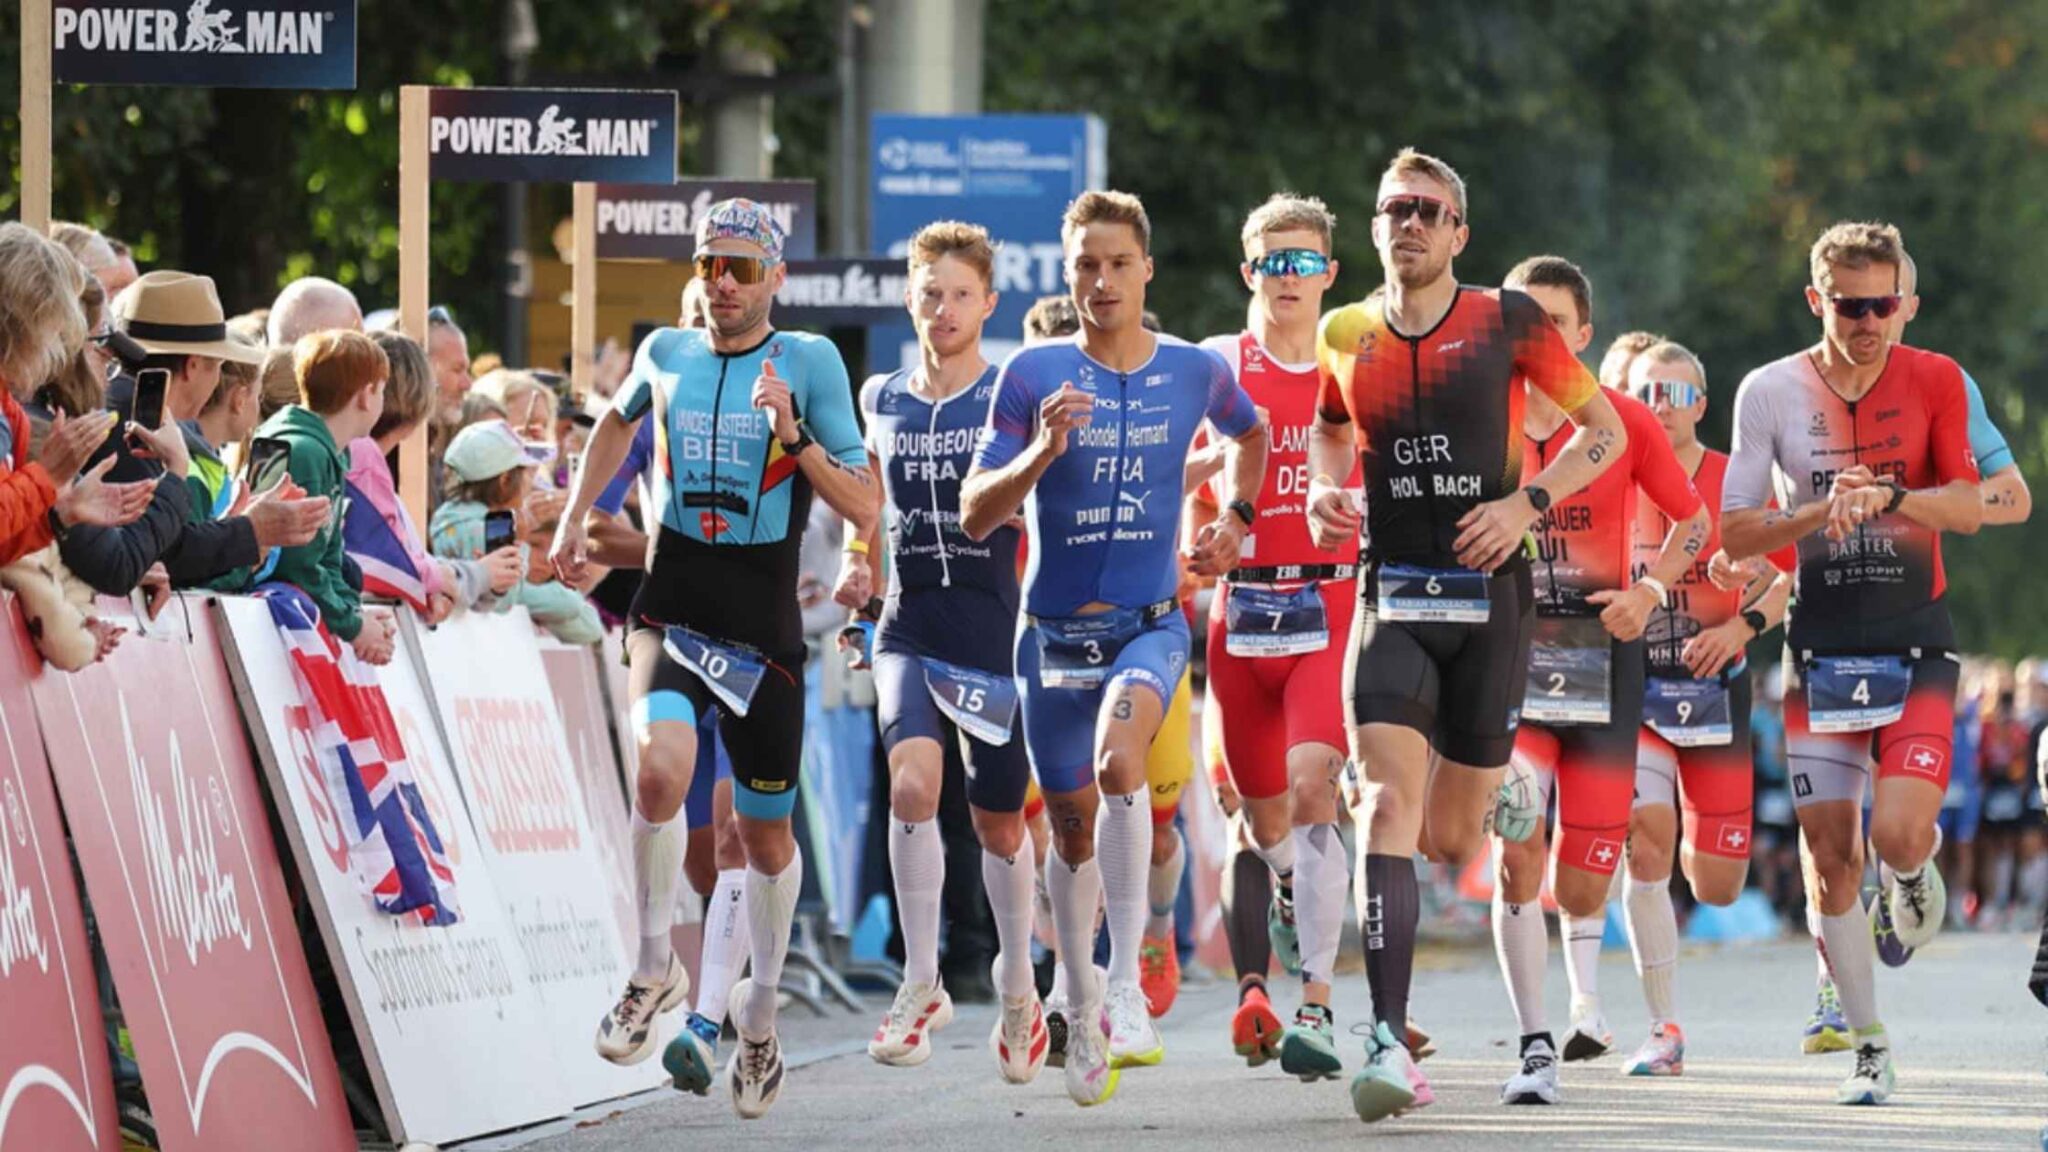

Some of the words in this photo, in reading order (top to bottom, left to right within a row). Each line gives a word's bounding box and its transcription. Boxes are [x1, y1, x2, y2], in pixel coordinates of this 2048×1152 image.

[55, 8, 178, 51] POWER
[247, 11, 322, 54] MAN
[431, 116, 532, 154] POWER
[586, 119, 649, 156] MAN
[597, 200, 691, 235] POWER
[777, 275, 842, 306] OWER
[683, 436, 751, 467] BEL
[1394, 434, 1453, 465] GER
[904, 459, 959, 481] FRA
[1092, 456, 1144, 483] FRA
[1845, 566, 1904, 576] TROPHY
[1425, 576, 1442, 595] 6
[1266, 611, 1283, 632] 7
[700, 646, 728, 679] 10
[1083, 639, 1103, 664] 3
[1547, 672, 1566, 697] 2
[1851, 678, 1871, 706] 4
[956, 684, 986, 713] 15
[1112, 699, 1132, 721] 3
[1676, 700, 1692, 725] 9
